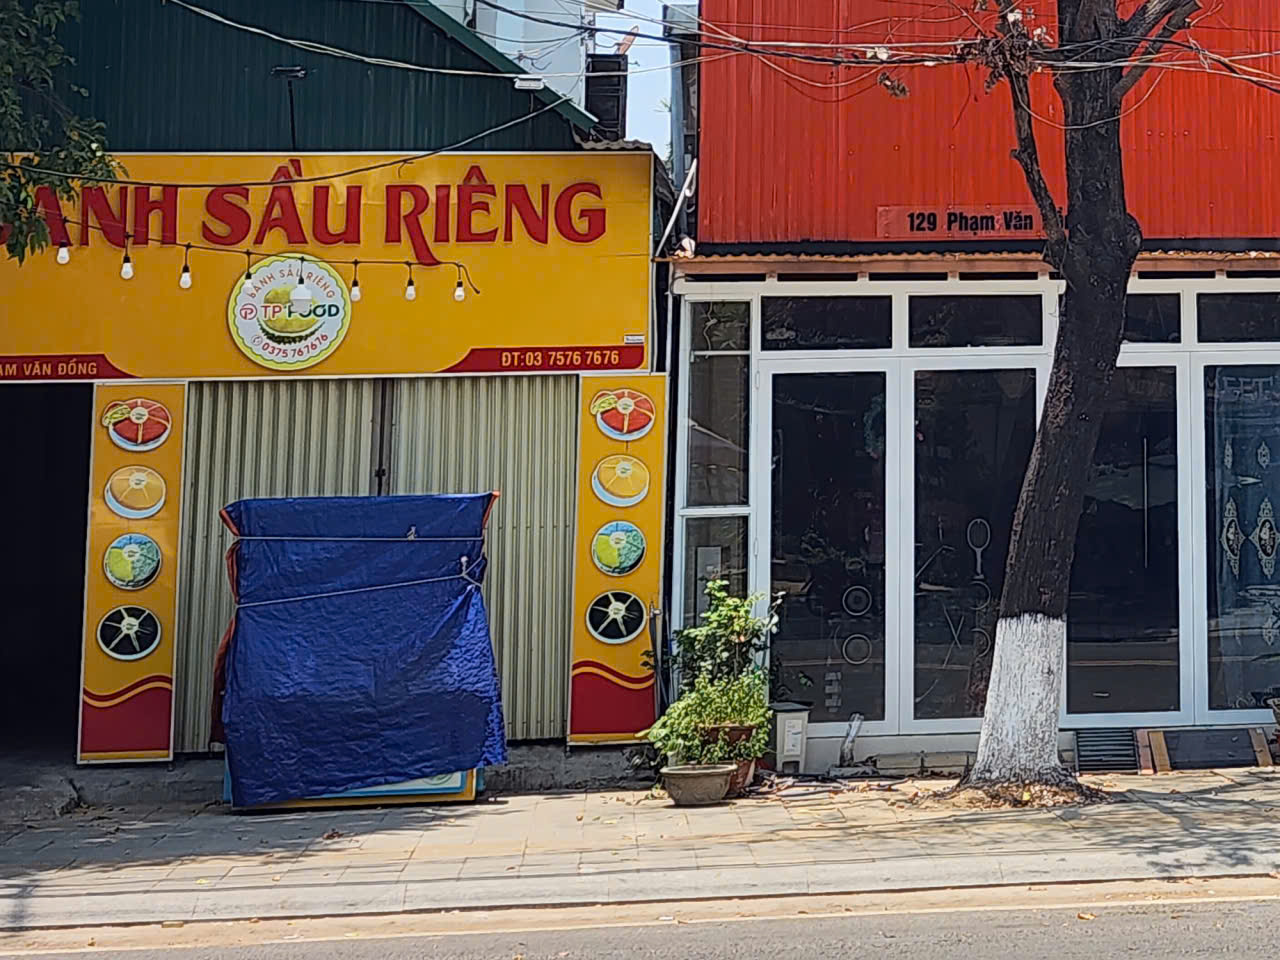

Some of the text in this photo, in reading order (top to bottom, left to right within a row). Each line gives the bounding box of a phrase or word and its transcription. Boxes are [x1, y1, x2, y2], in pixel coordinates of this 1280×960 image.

[201, 158, 362, 247] SẦU
[384, 164, 607, 267] RIÊNG
[907, 212, 937, 232] 129
[947, 211, 995, 235] Phạm
[1003, 211, 1033, 230] Văn
[23, 360, 52, 376] VĂN
[548, 351, 582, 366] 7576
[585, 350, 619, 365] 7676
